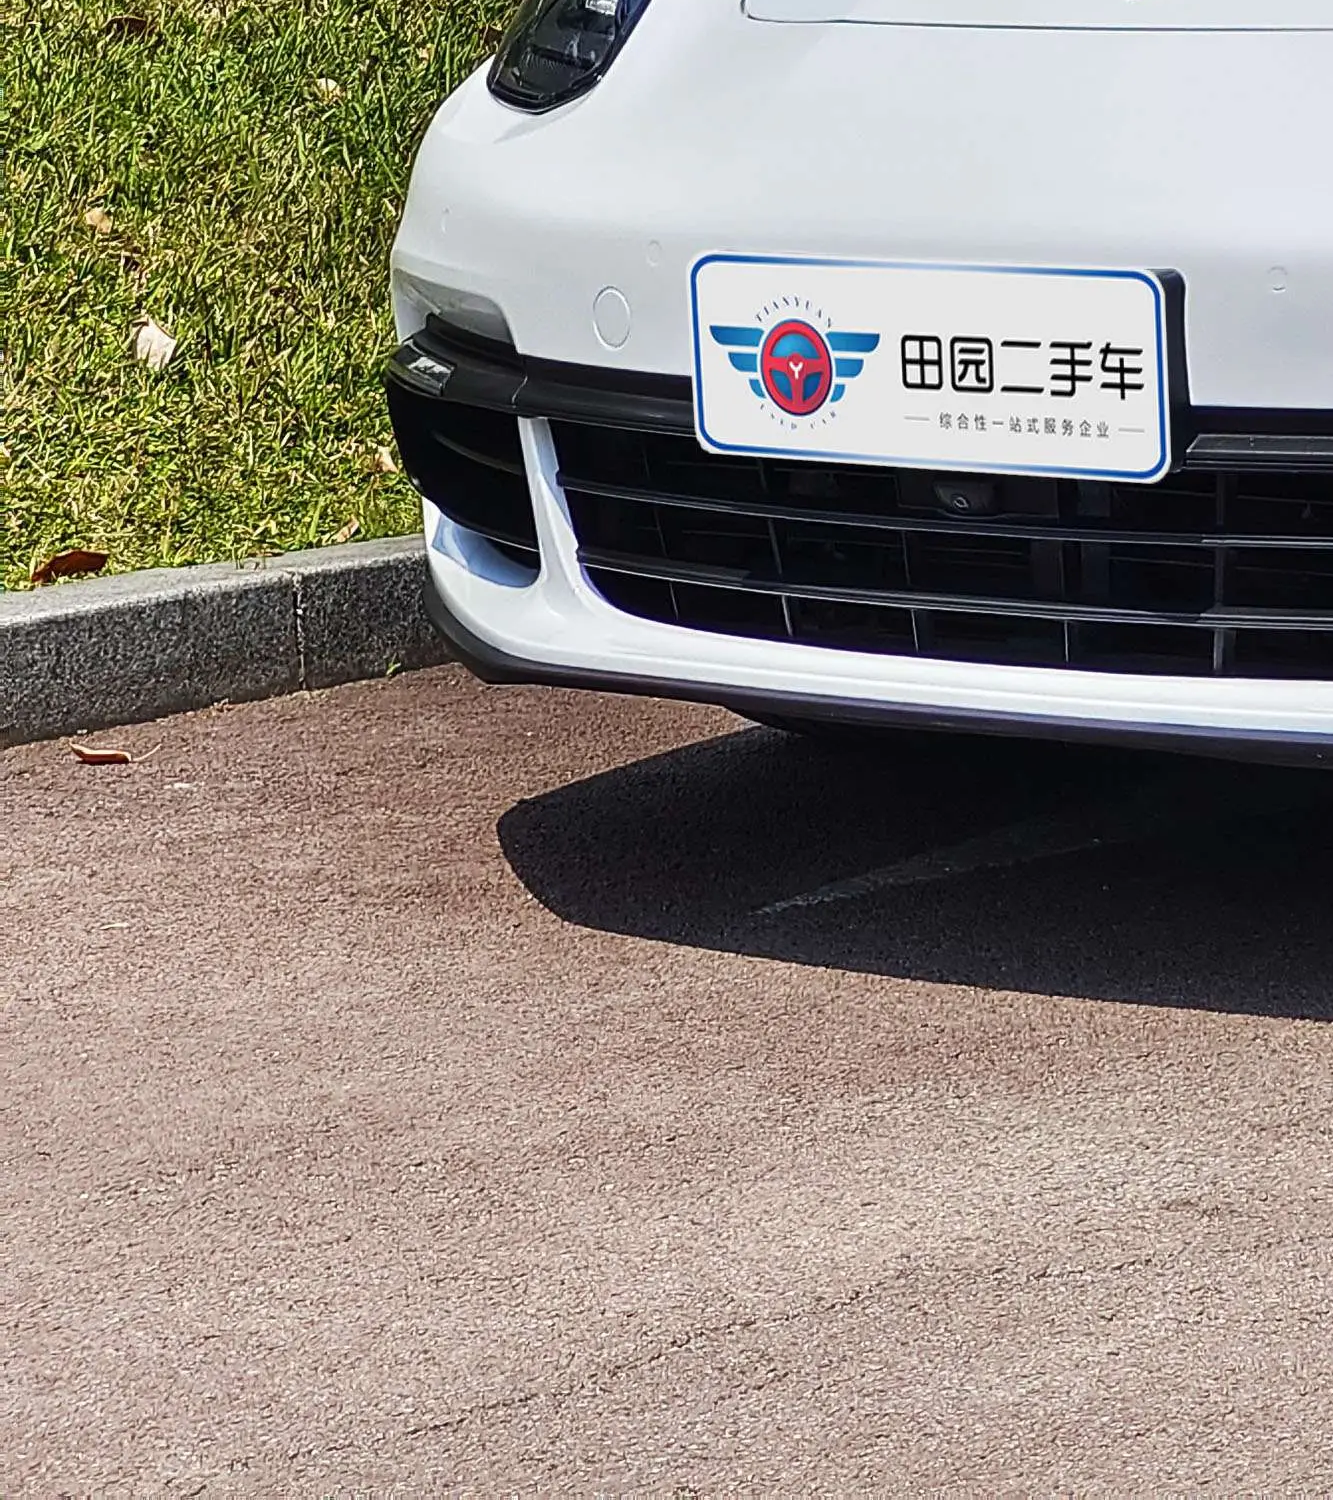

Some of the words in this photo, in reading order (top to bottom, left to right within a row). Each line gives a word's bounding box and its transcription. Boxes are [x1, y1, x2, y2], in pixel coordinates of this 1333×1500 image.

[900, 334, 1146, 400] 田园二手车
[939, 411, 1110, 439] 综合性一站式服务企业
